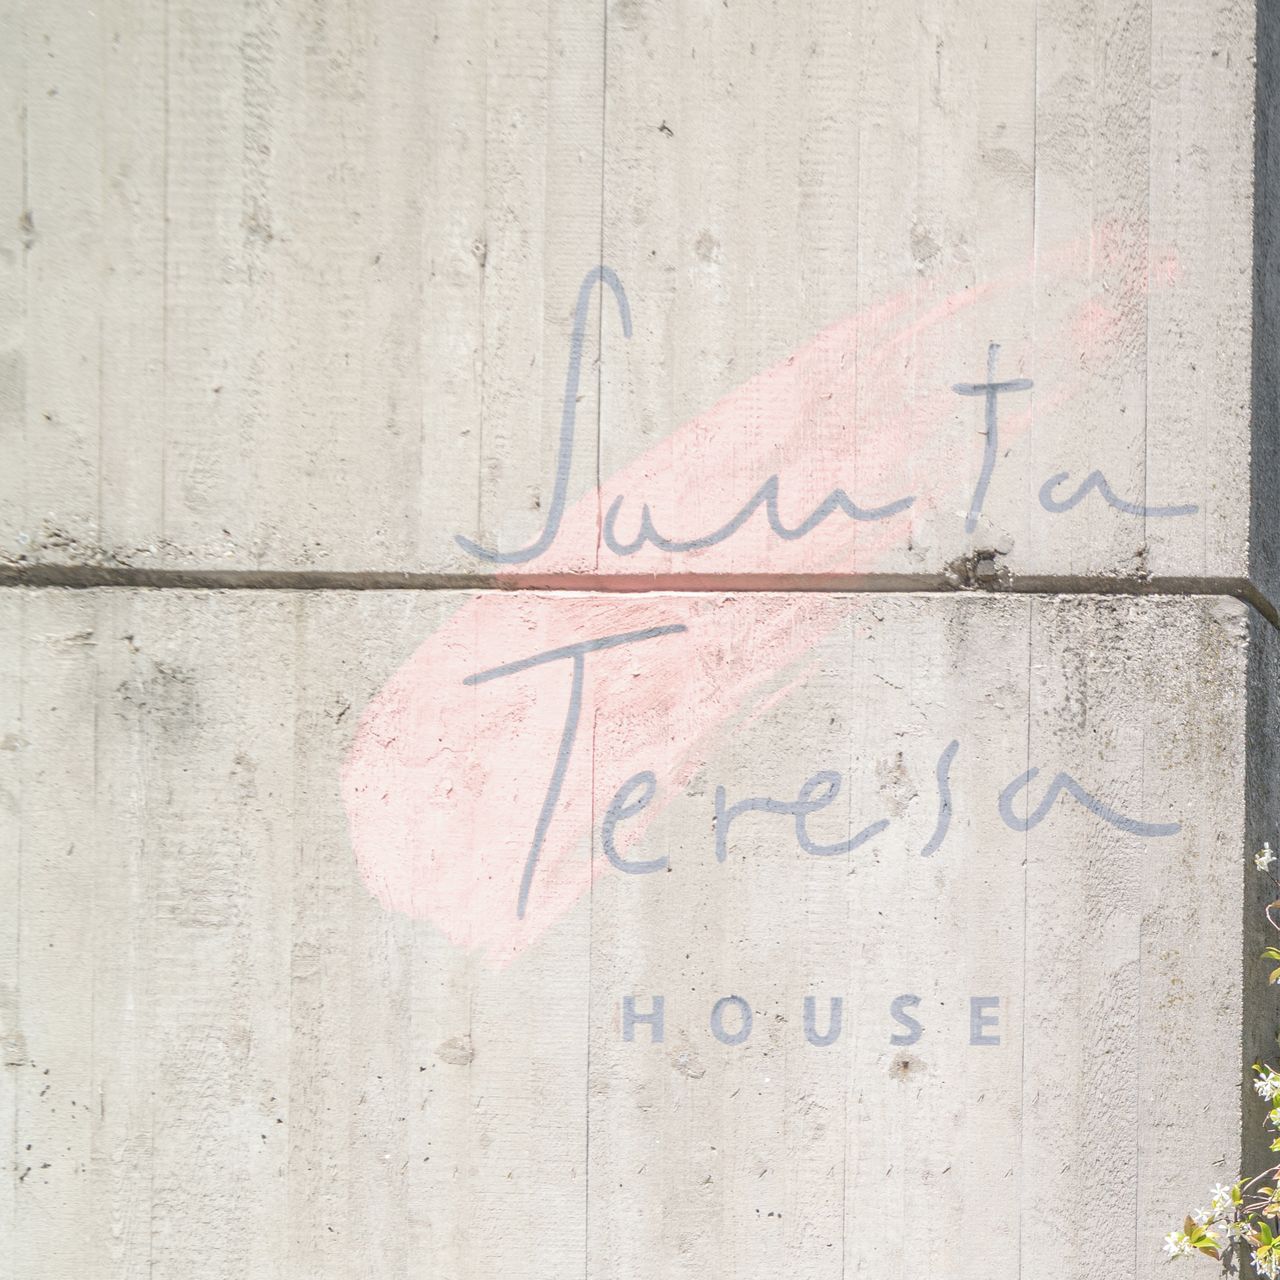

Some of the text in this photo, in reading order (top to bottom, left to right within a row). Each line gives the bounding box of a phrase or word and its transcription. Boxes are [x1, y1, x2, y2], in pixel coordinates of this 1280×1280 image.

[455, 266, 1199, 564] Santa
[464, 624, 1182, 919] Teresa
[622, 994, 1001, 1047] HOUSE
